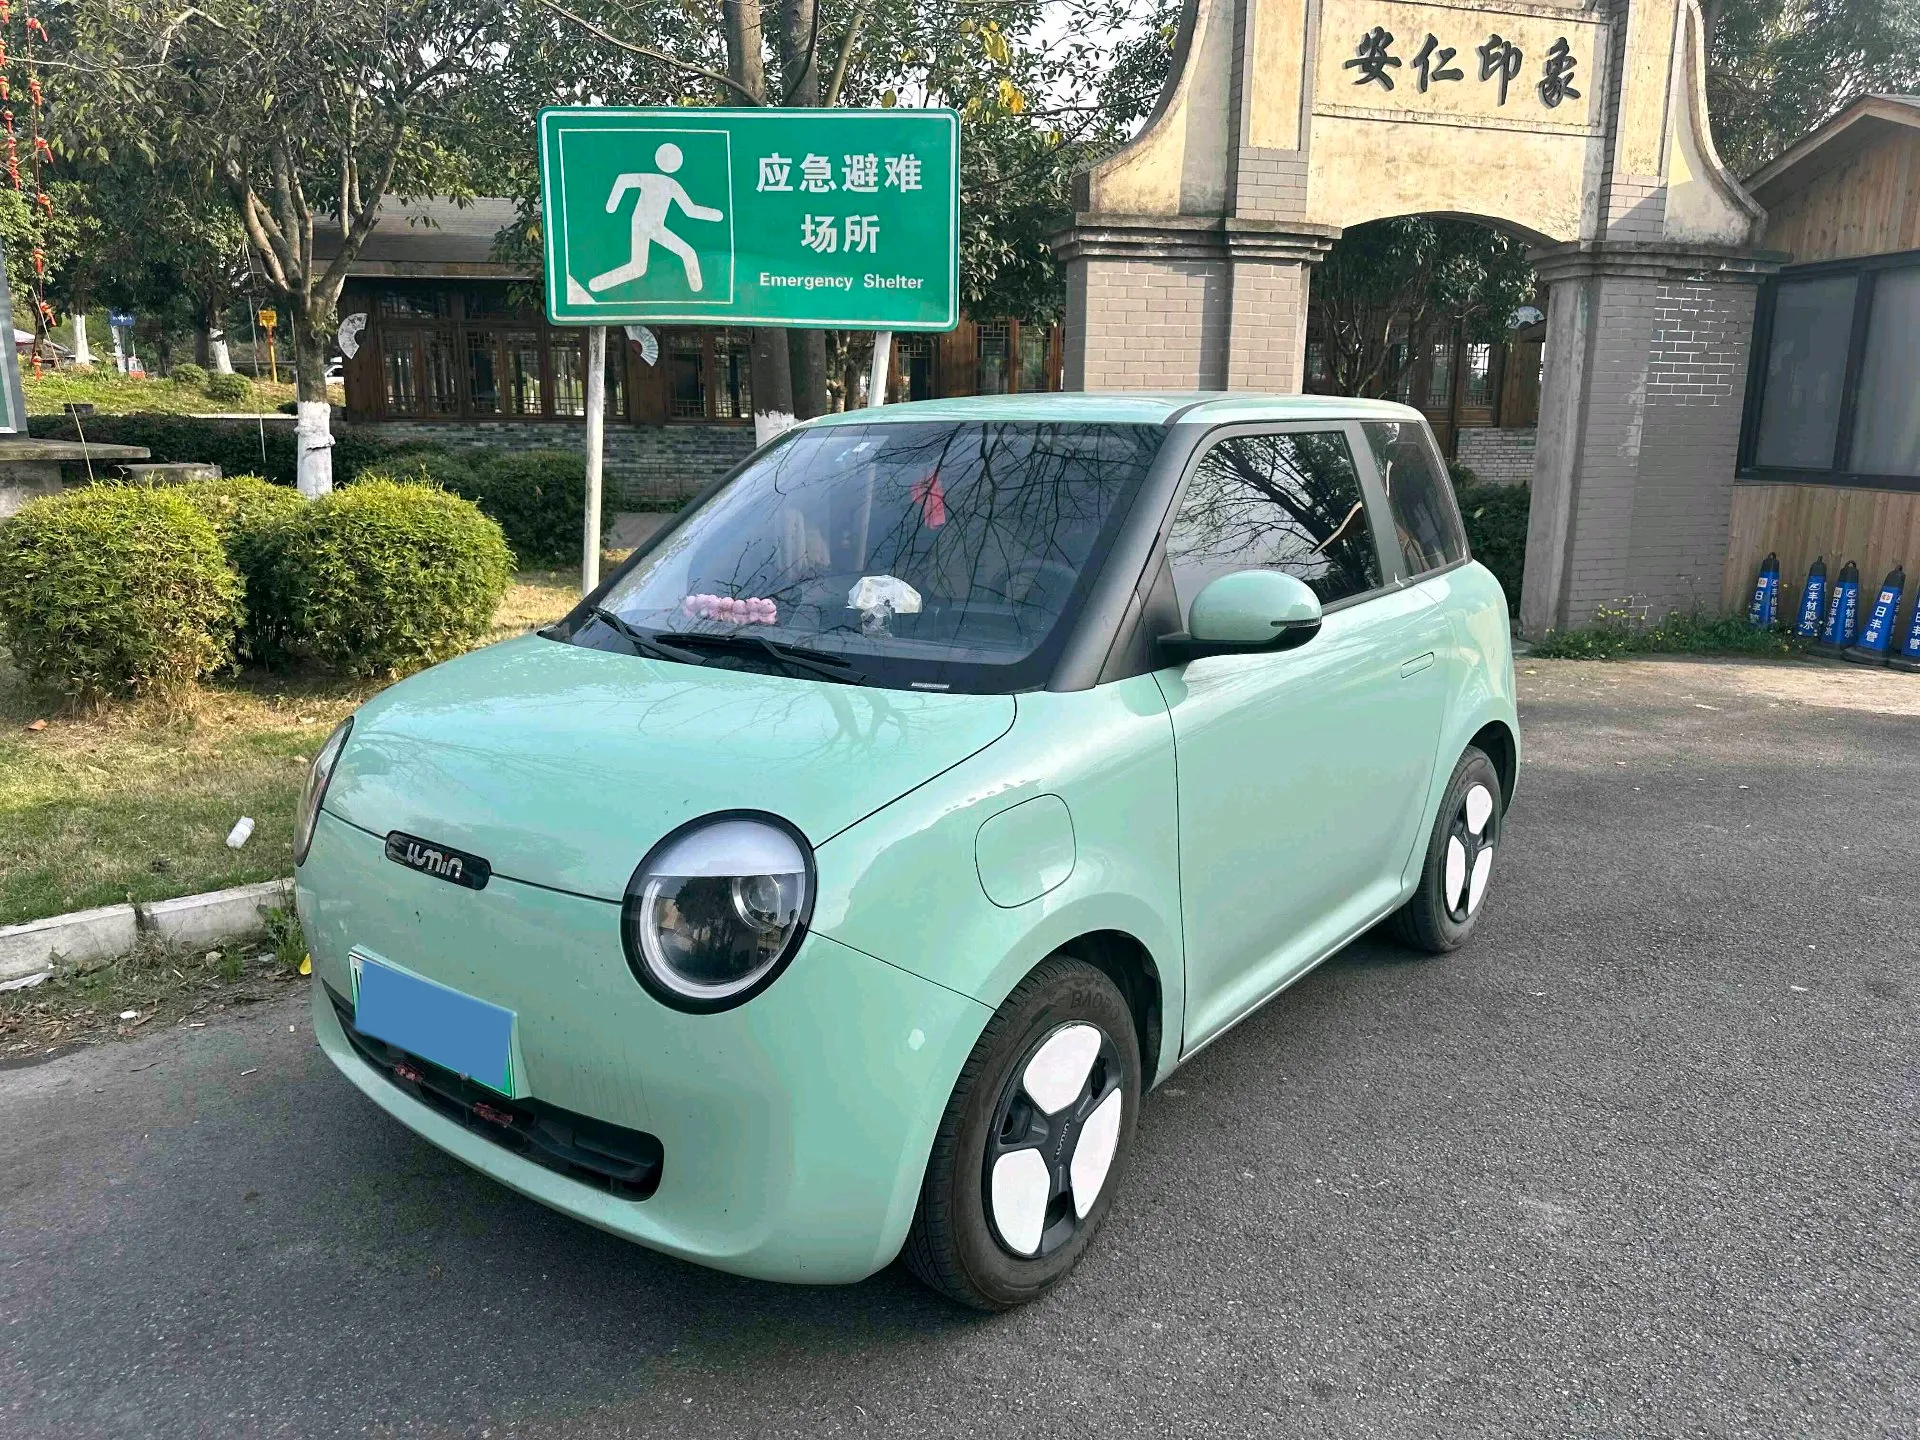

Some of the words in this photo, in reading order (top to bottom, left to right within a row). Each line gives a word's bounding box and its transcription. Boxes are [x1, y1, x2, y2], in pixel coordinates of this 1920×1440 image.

[1342, 26, 1581, 109] 安仁印象
[756, 152, 922, 193] 应急避难
[801, 213, 880, 254] 场所
[759, 272, 853, 292] Emergency
[864, 274, 924, 290] Shelter
[1803, 592, 1818, 629] 丰材防水
[1844, 599, 1856, 638] 丰材防水
